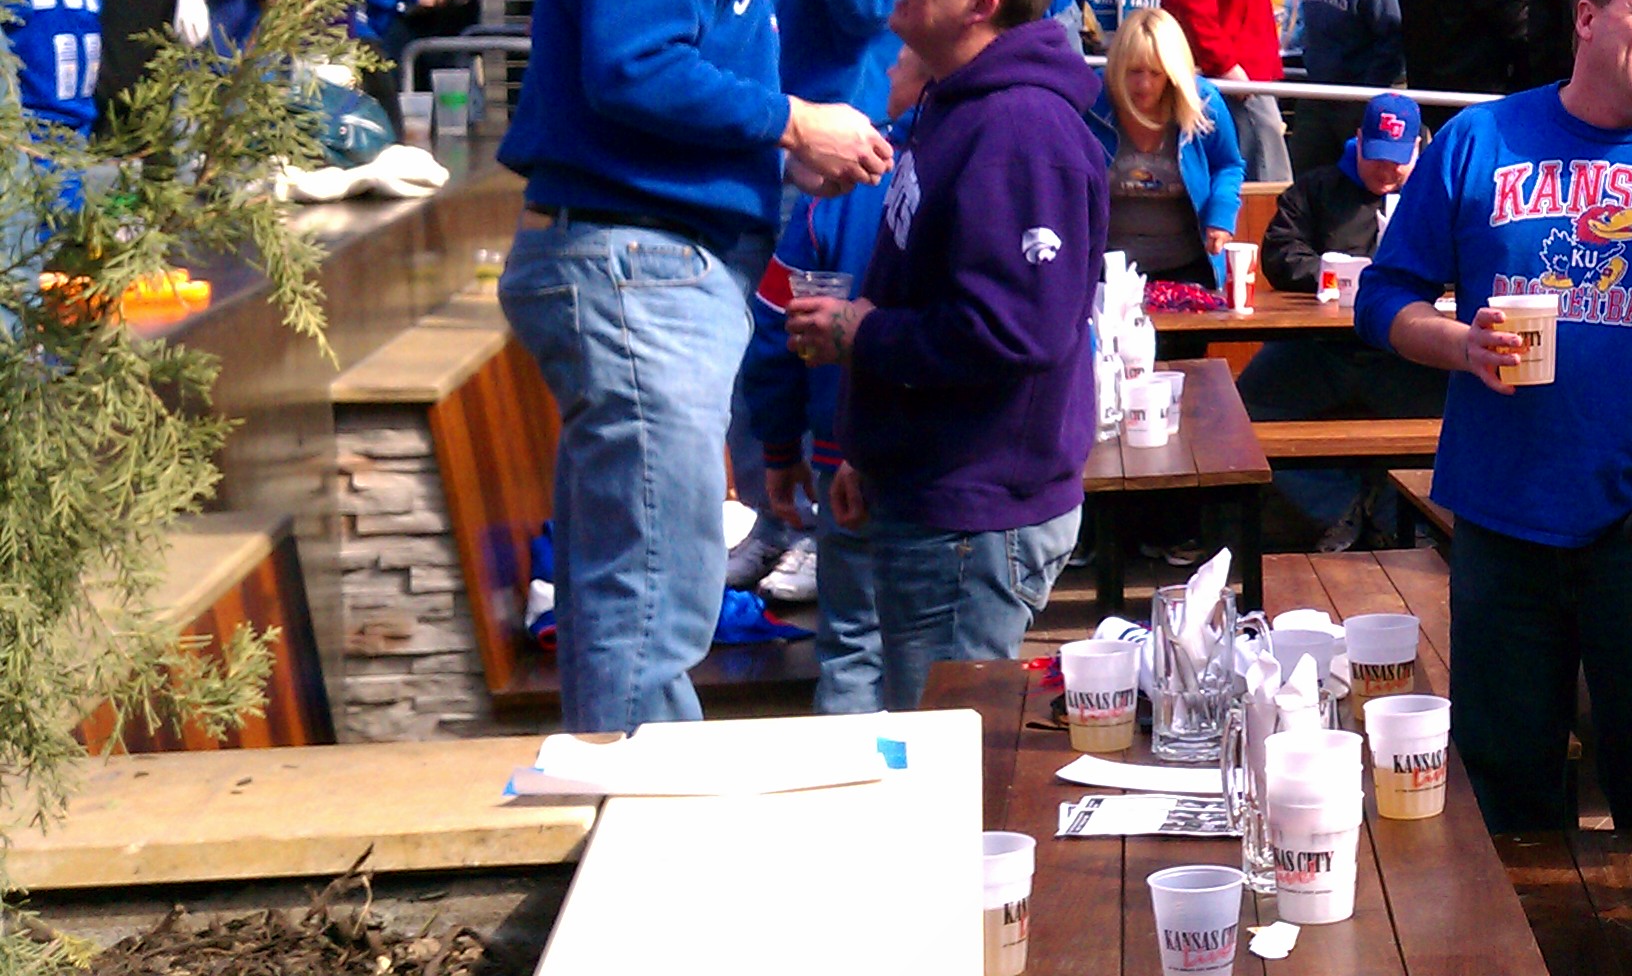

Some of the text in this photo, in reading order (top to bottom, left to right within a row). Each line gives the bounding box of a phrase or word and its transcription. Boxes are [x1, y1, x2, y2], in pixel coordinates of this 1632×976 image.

[1571, 249, 1598, 268] KU
[1352, 661, 1396, 682] KANSAS
[1066, 688, 1136, 710] KANSAS CITY
[1393, 750, 1443, 774] KANSAS
[1297, 850, 1335, 873] CITY
[1164, 928, 1220, 952] KANSAS
